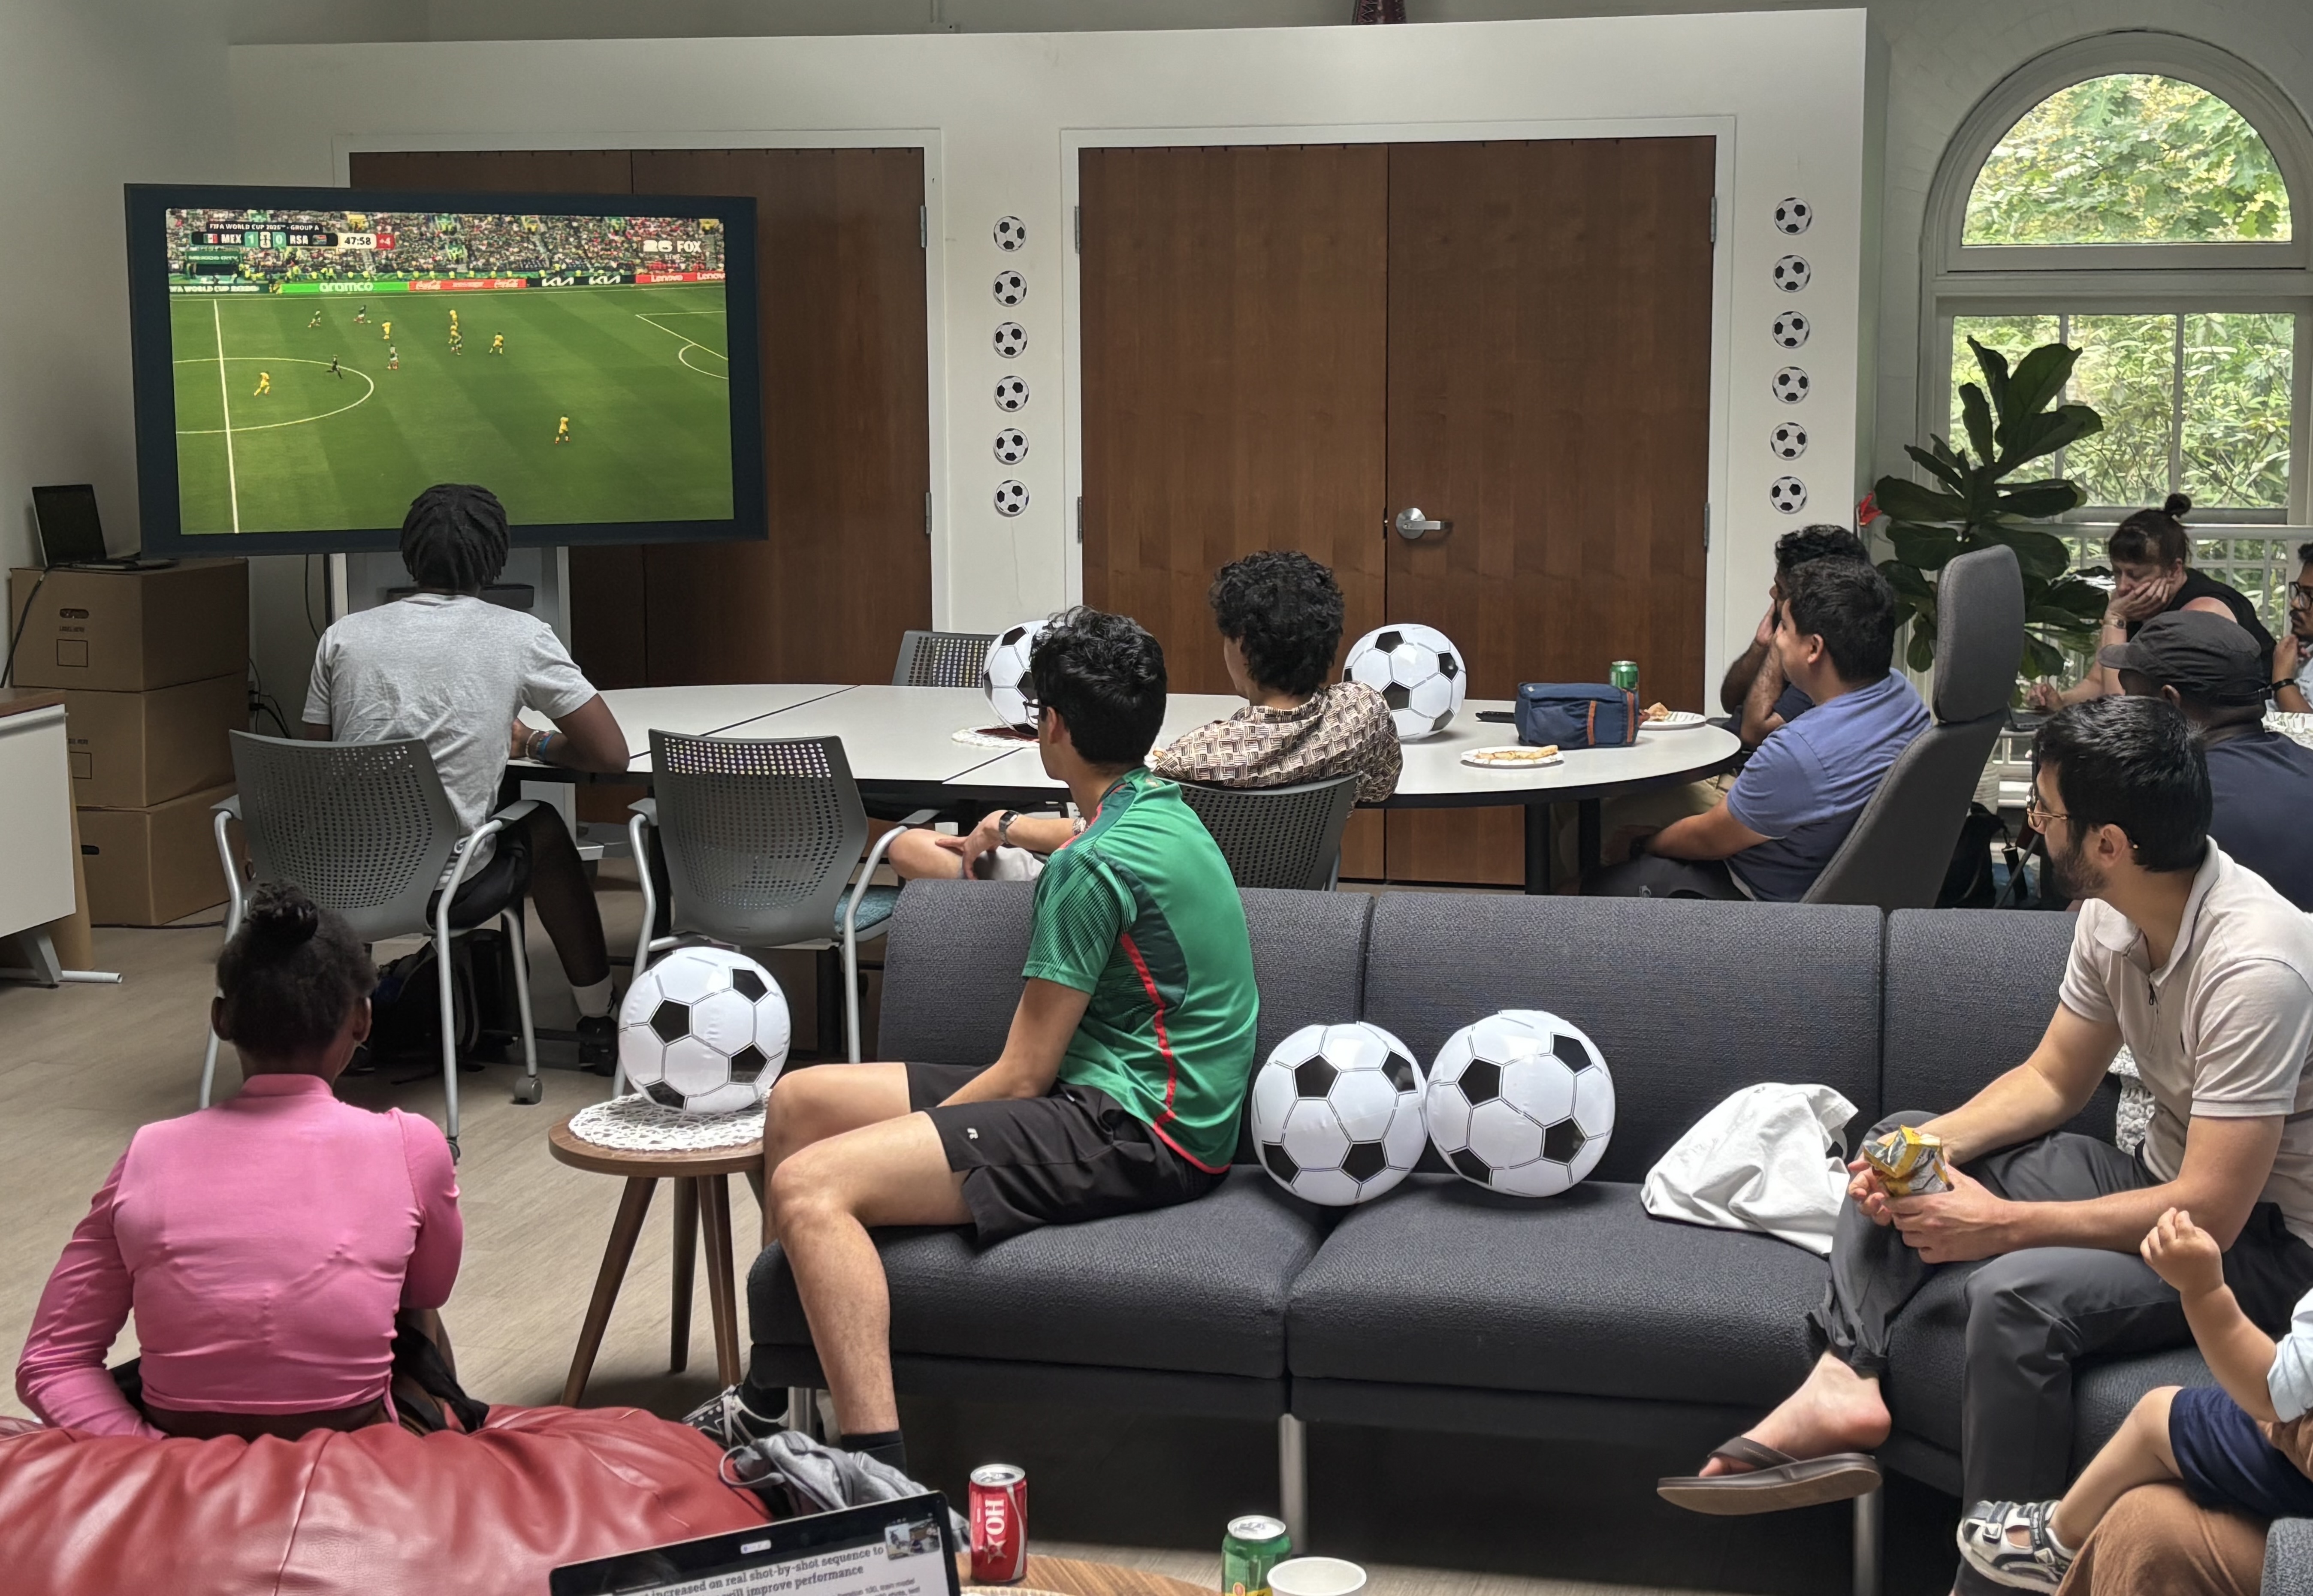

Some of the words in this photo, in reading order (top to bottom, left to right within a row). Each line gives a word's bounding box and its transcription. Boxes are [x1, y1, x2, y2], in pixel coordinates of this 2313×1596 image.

[221, 234, 242, 244] MEX
[249, 234, 254, 244] 1
[275, 234, 283, 244] 0
[290, 235, 308, 244] RSA
[344, 236, 371, 245] 47:58
[676, 240, 702, 253] FOX
[651, 273, 683, 282] Lenovo
[319, 282, 374, 292] aramco
[709, 1579, 723, 1590] on
[725, 1572, 748, 1586] real
[749, 1558, 819, 1581] shot-by-shot
[821, 1549, 870, 1566] sequence
[873, 1546, 884, 1555] to
[746, 1581, 792, 1596] improve
[794, 1566, 864, 1590] performance
